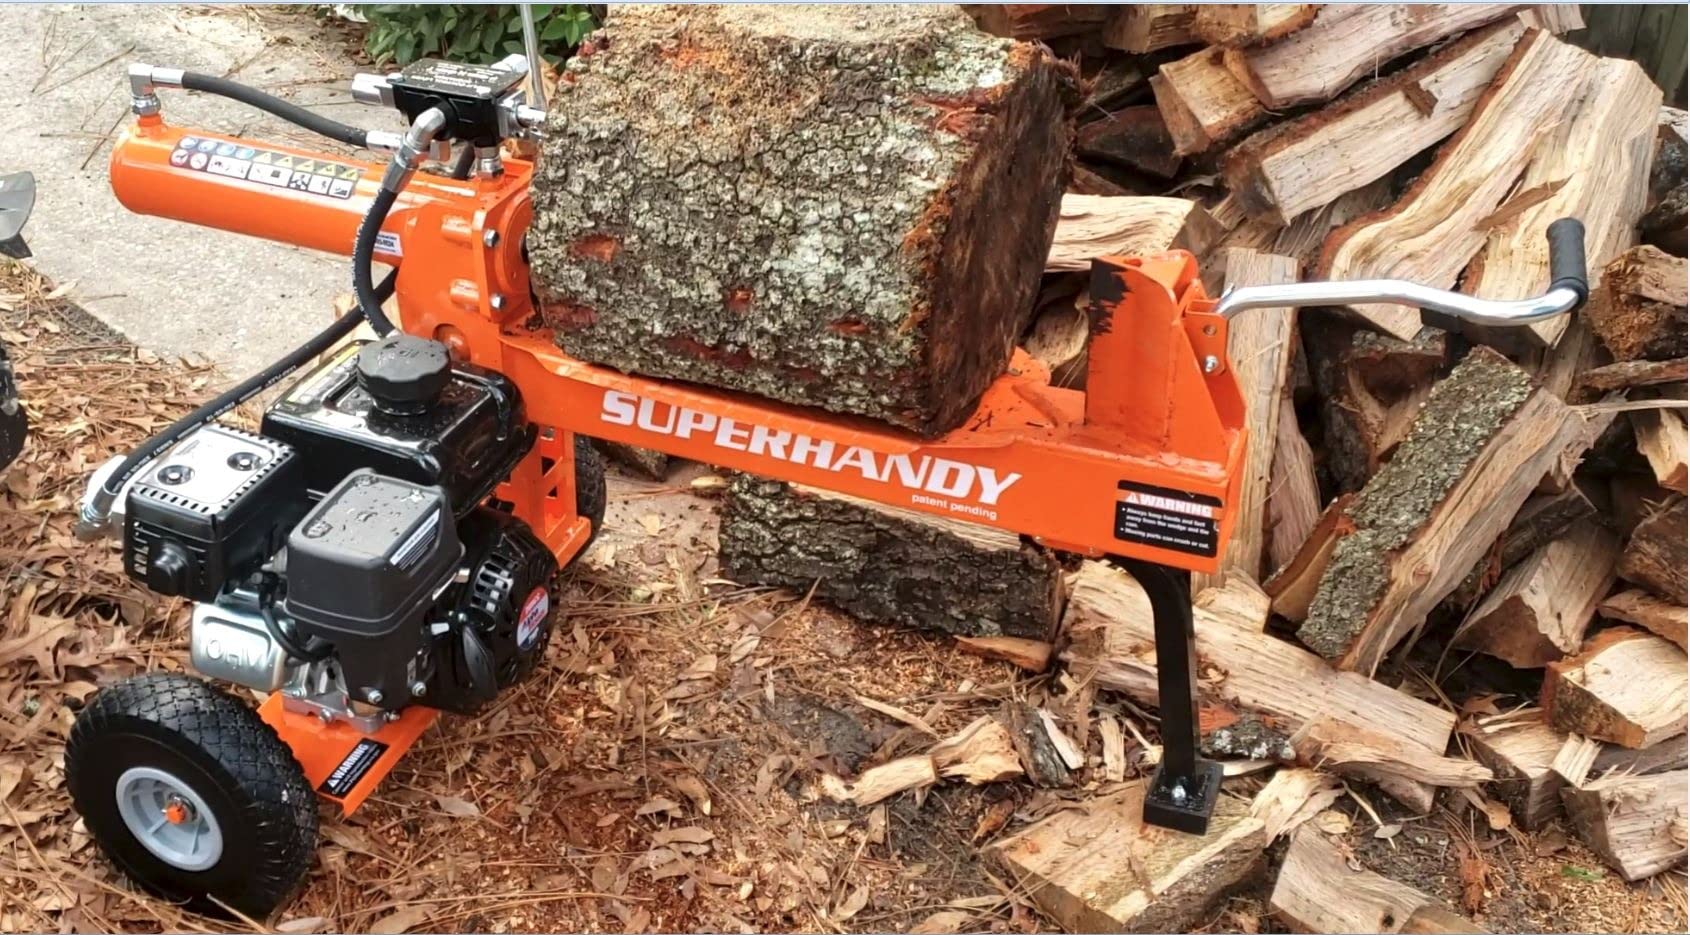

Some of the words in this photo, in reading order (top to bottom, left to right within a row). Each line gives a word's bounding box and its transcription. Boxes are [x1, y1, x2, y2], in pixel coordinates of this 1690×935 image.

[600, 390, 1022, 505] SUPERHANDY
[912, 494, 947, 509] patent
[950, 503, 997, 521] pending
[1139, 493, 1213, 518] WARNING
[331, 743, 370, 779] WARNING
